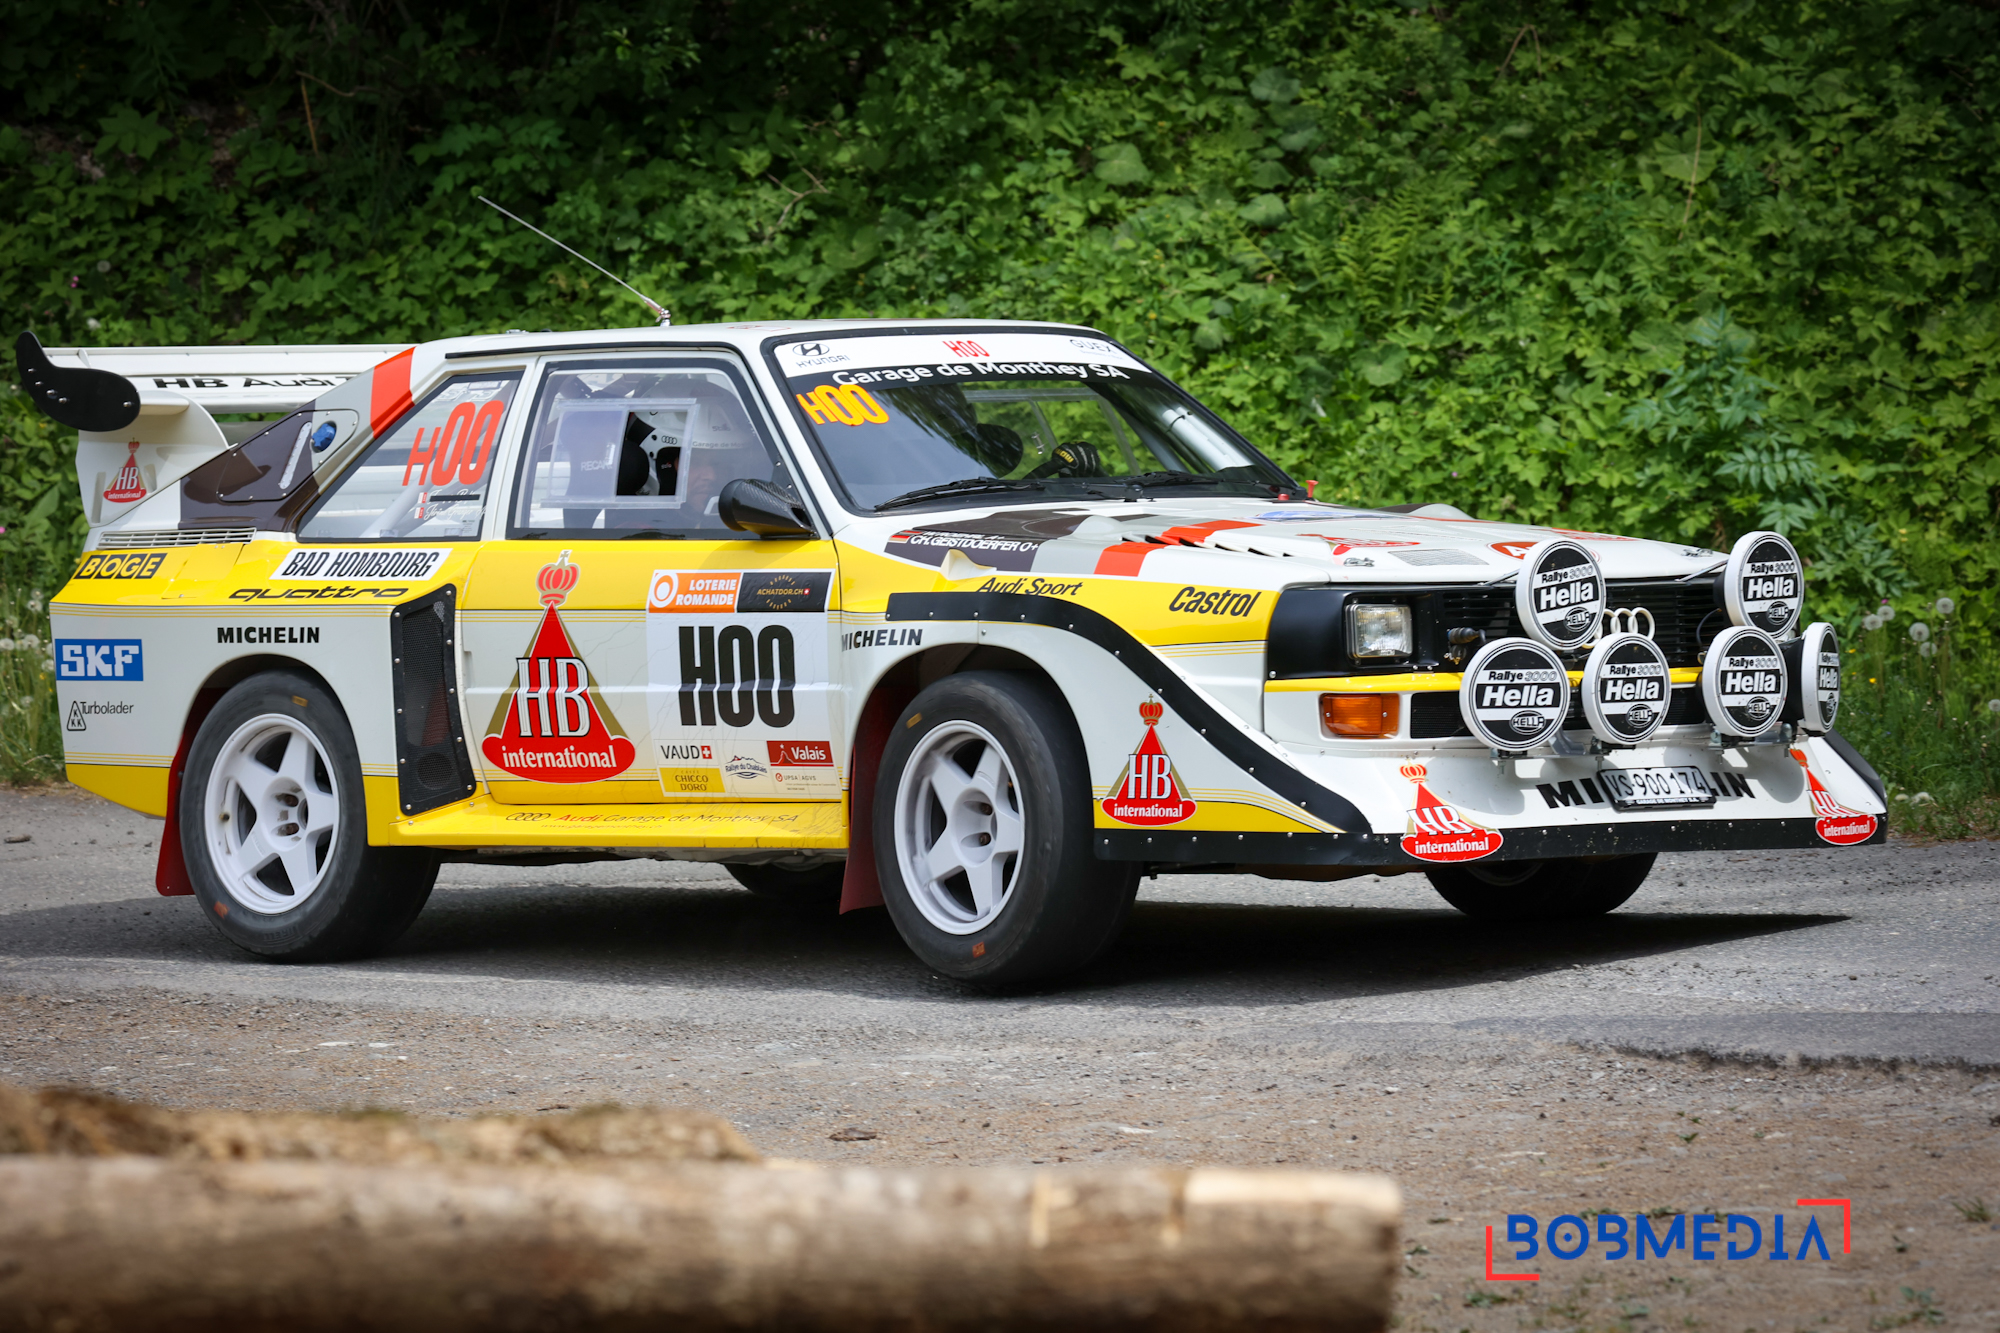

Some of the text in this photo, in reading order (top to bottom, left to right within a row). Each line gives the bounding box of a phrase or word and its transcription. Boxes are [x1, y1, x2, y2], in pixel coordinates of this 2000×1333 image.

[796, 354, 850, 368] HYUNDAI
[832, 362, 1130, 385] Garage de Monthey SA
[153, 378, 229, 388] HB
[116, 466, 138, 491] HB
[107, 490, 142, 500] international
[82, 555, 164, 578] BOGE
[281, 552, 440, 578] BAD HOMBOURG
[1542, 564, 1594, 584] Rallye 3000
[1750, 562, 1795, 574] Rallye 3000
[228, 586, 409, 602] quattro
[688, 579, 737, 591] LOTERIE
[975, 577, 1084, 596] Audi Sport
[1747, 576, 1795, 600] Hella
[675, 594, 734, 606] ROMANDE
[1168, 586, 1262, 618] Castrol
[1540, 582, 1594, 610] Hella
[217, 626, 320, 644] MICHELIN
[842, 628, 923, 652] MICHELIN
[60, 645, 140, 677] SKF
[1609, 664, 1662, 676] Rallye 3000
[1728, 658, 1778, 668] Rallye 3000
[1488, 670, 1557, 682] Rallye 3000
[1725, 671, 1776, 693] Hella
[515, 657, 590, 738] HB
[1482, 685, 1554, 707] Hella
[1604, 678, 1660, 700] Hella
[80, 700, 134, 714] Turbolader
[502, 745, 617, 769] international
[660, 745, 700, 760] VAUD
[790, 745, 826, 761] Valais
[674, 774, 708, 782] CHICCO
[1126, 754, 1172, 800] HB
[554, 814, 800, 824] Audi Garage de Monthey SA
[1114, 803, 1183, 818] international
[1406, 804, 1474, 836] HB
[1823, 820, 1870, 837] international
[1414, 836, 1490, 854] international
